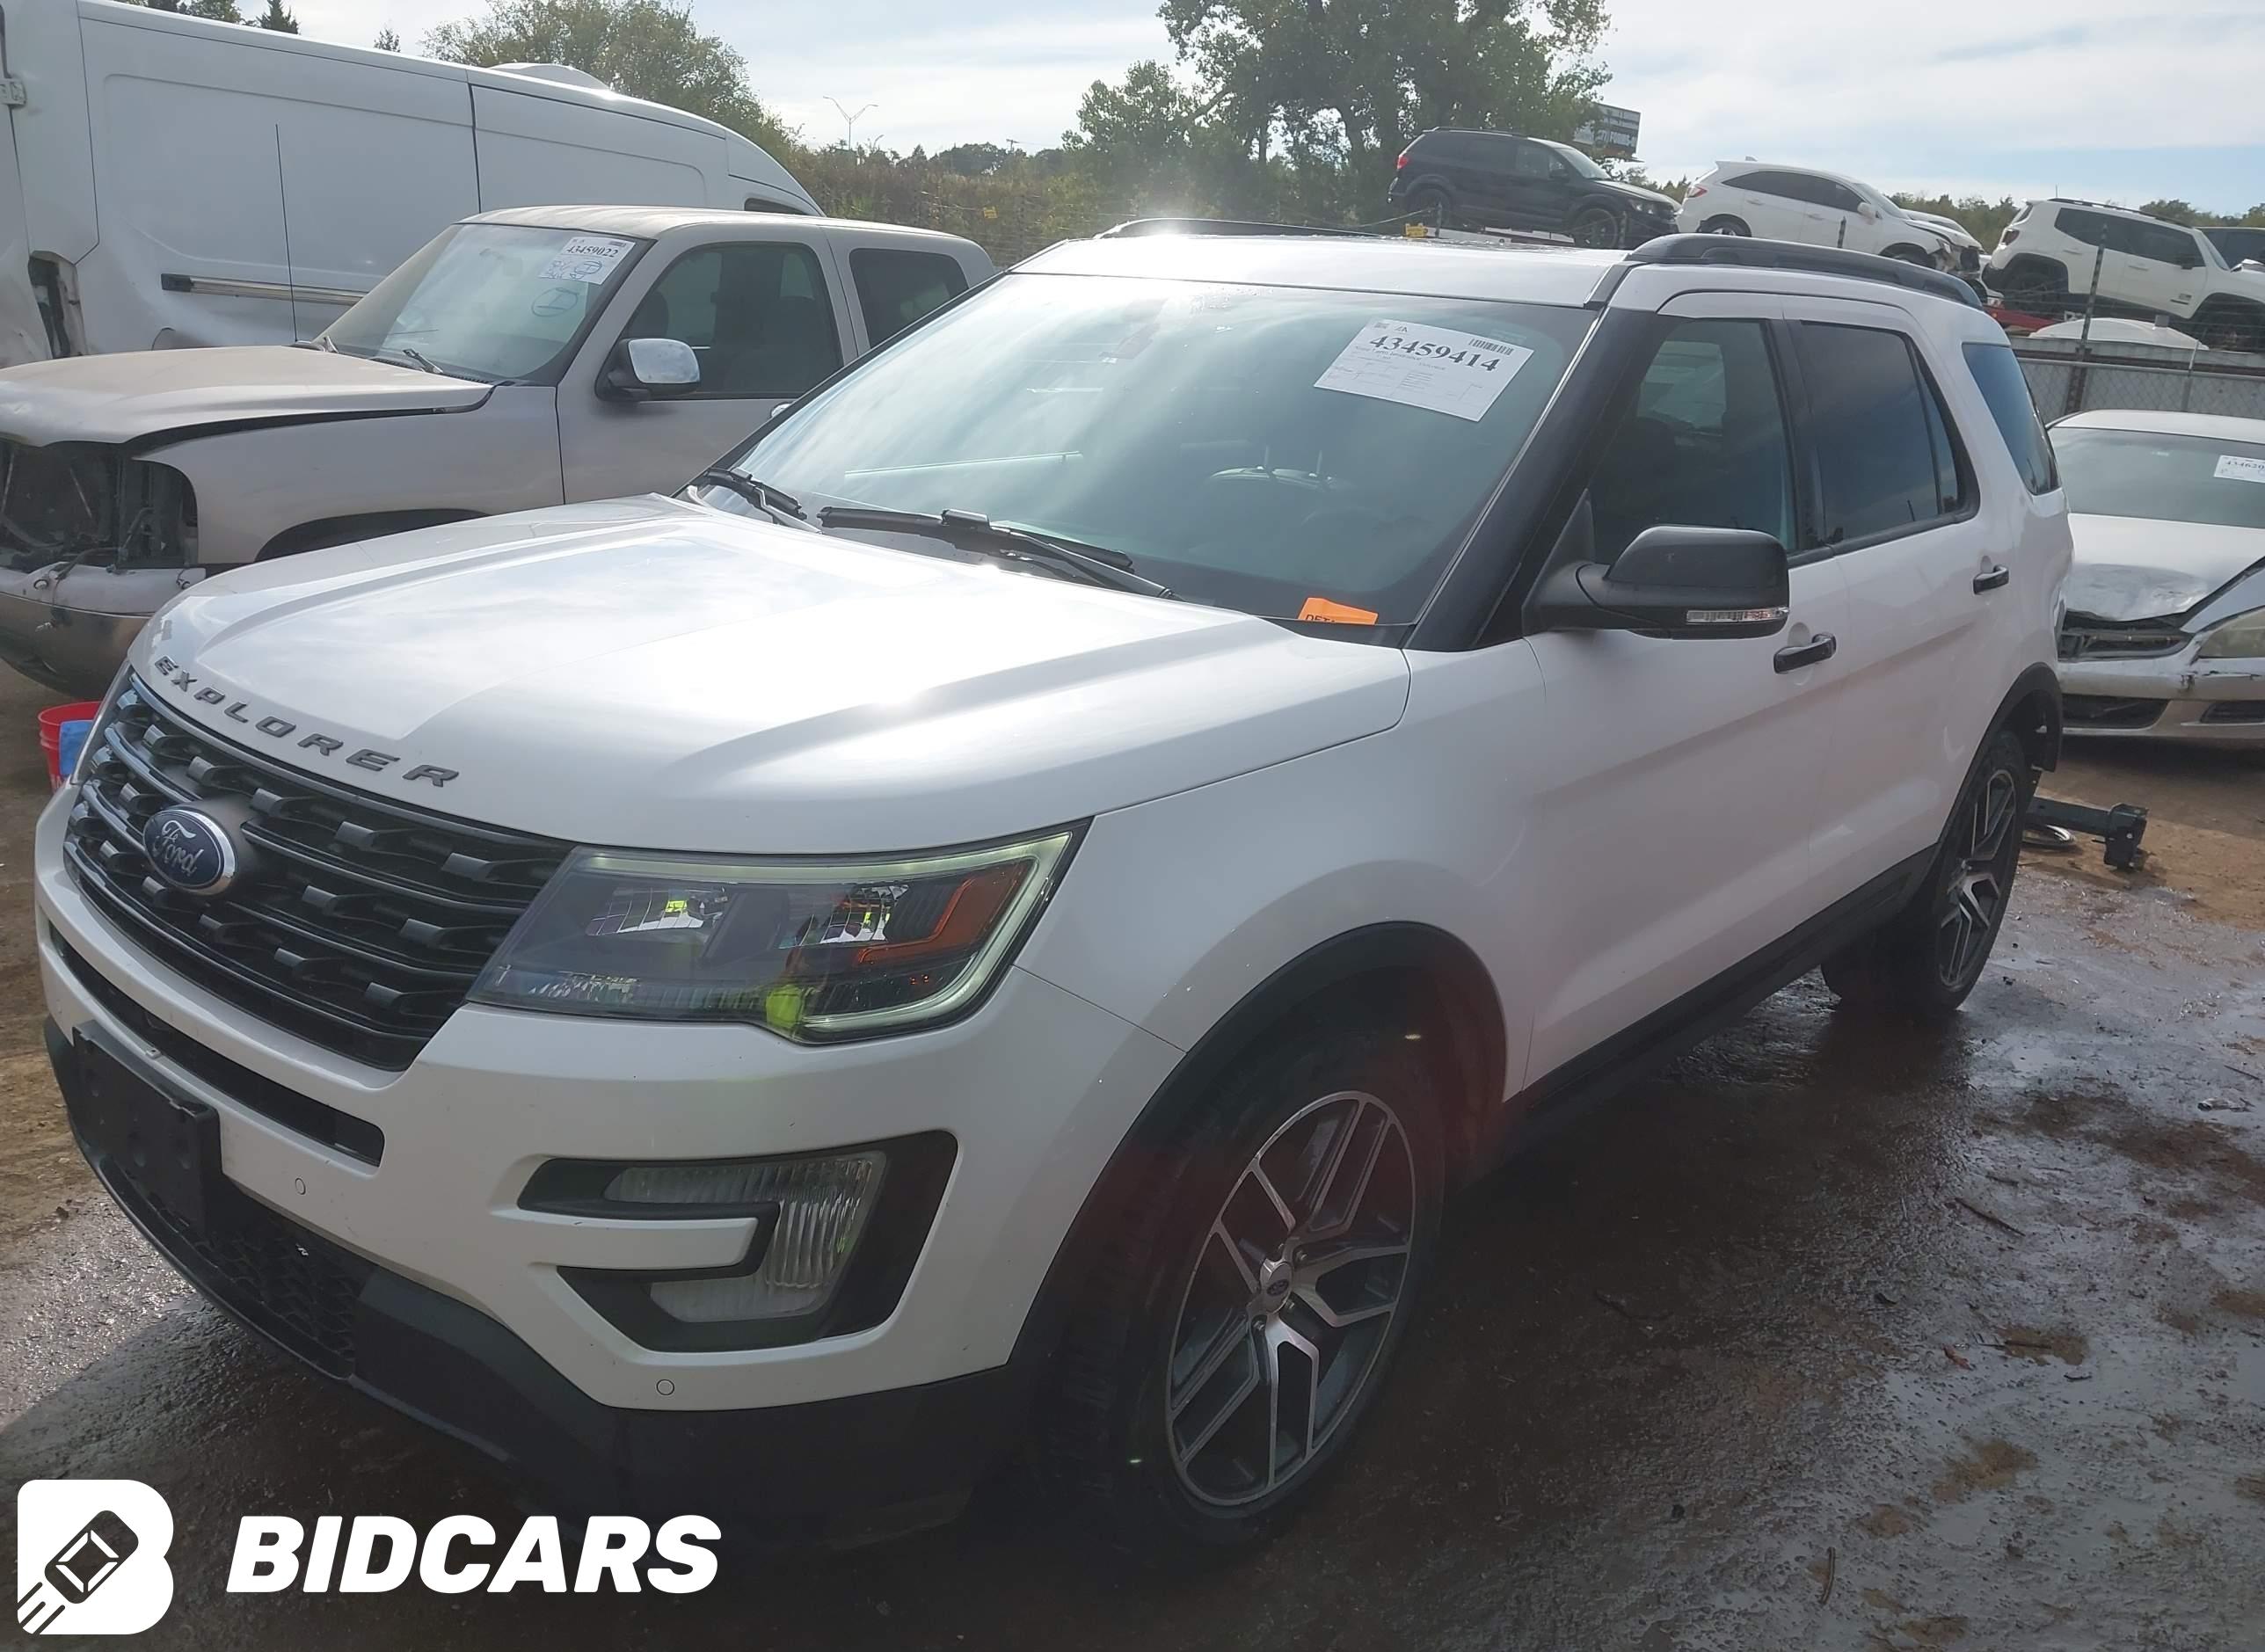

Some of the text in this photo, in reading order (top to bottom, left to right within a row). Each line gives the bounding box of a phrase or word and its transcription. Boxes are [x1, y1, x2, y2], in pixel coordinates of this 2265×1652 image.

[566, 246, 618, 258] 43459022
[1369, 335, 1500, 372] 43459414
[154, 655, 460, 787] EXPLORER
[151, 819, 204, 877] Ford
